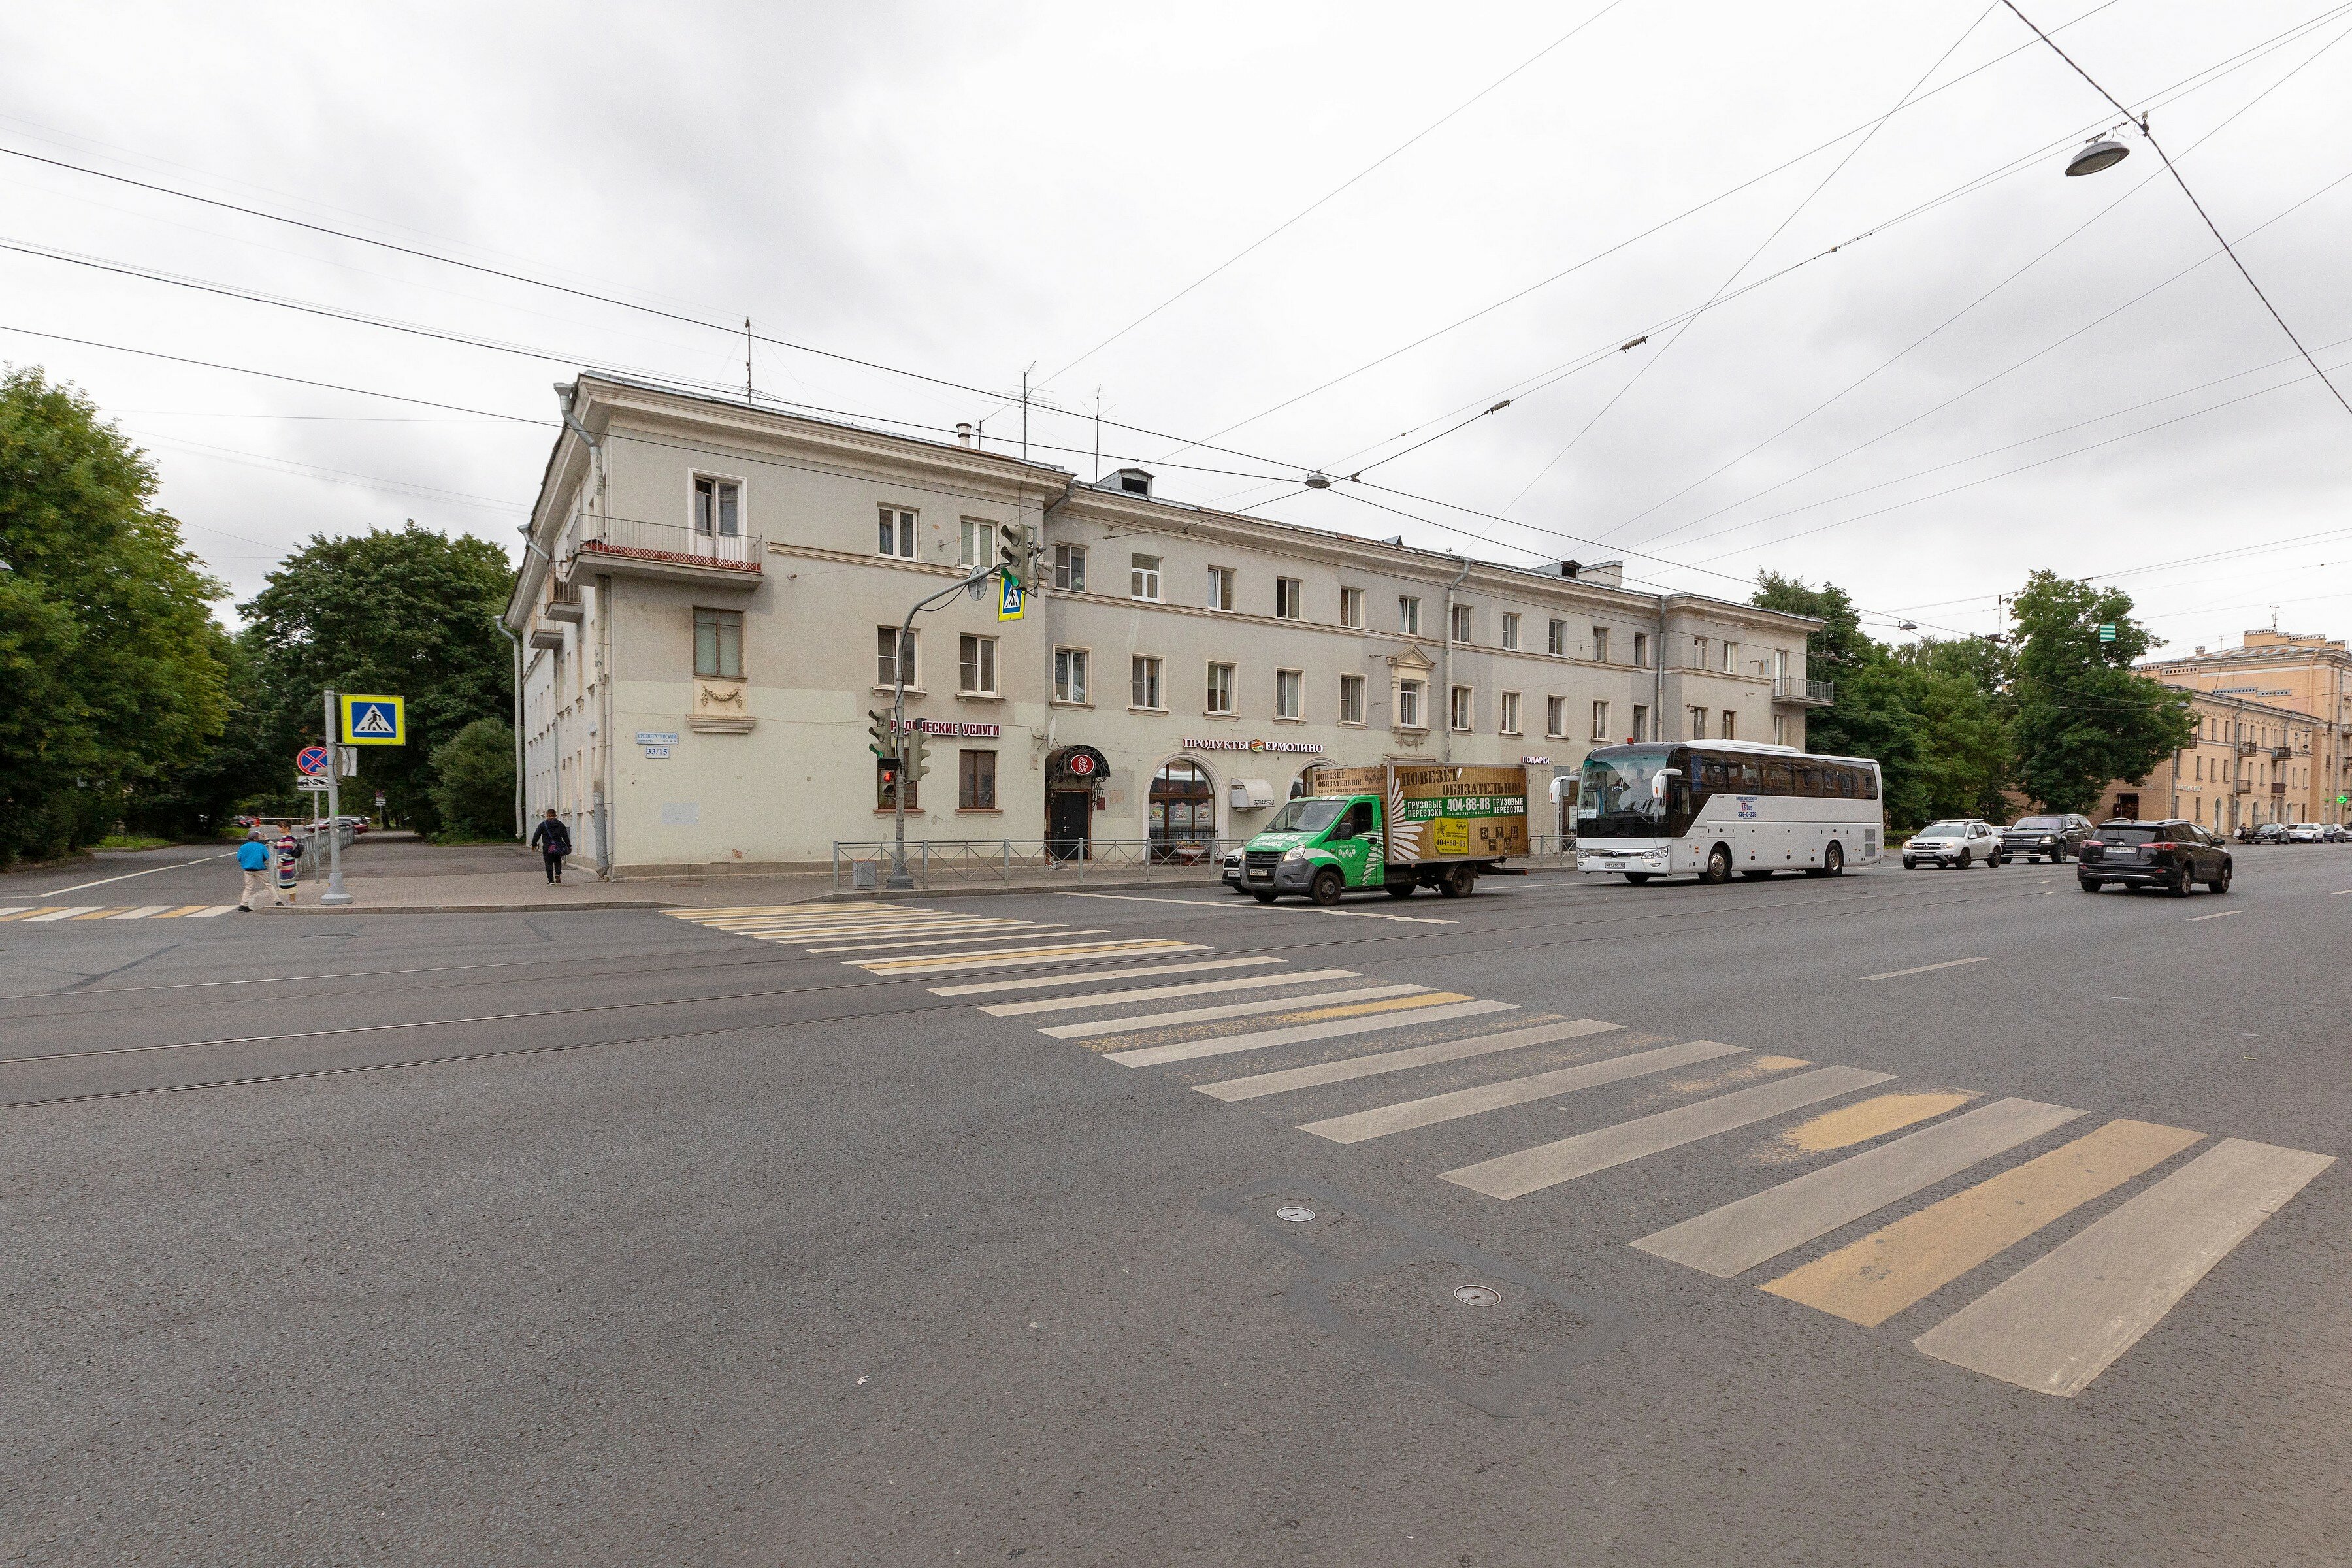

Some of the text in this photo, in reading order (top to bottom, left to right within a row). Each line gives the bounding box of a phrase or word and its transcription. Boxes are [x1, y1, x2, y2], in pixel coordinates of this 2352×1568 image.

[890, 719, 1000, 737] РДЧЕСКИЕ УСЛУГИ
[1183, 738, 1324, 753] ПРОДУКТЫ ЕРМОЛИНО
[1521, 755, 1550, 764] ПОДАРКИ
[1401, 766, 1458, 787] ПОВЕЗЁТ
[1318, 779, 1362, 788] ОБЯЗАТЕЛЬНО!
[1442, 782, 1521, 796] ОБЯЗАТЕЛЬНО!
[1407, 800, 1443, 809] ГРУЗОВЫЕ
[1446, 797, 1490, 811] 404-88-88
[1493, 797, 1524, 806] ГРУЗОВЫЕ
[1407, 808, 1443, 817] ПЕРЕВОЗКИ
[1493, 806, 1524, 814] ПЕРЕВОЗКИ
[1436, 838, 1466, 847] 404-88-88
